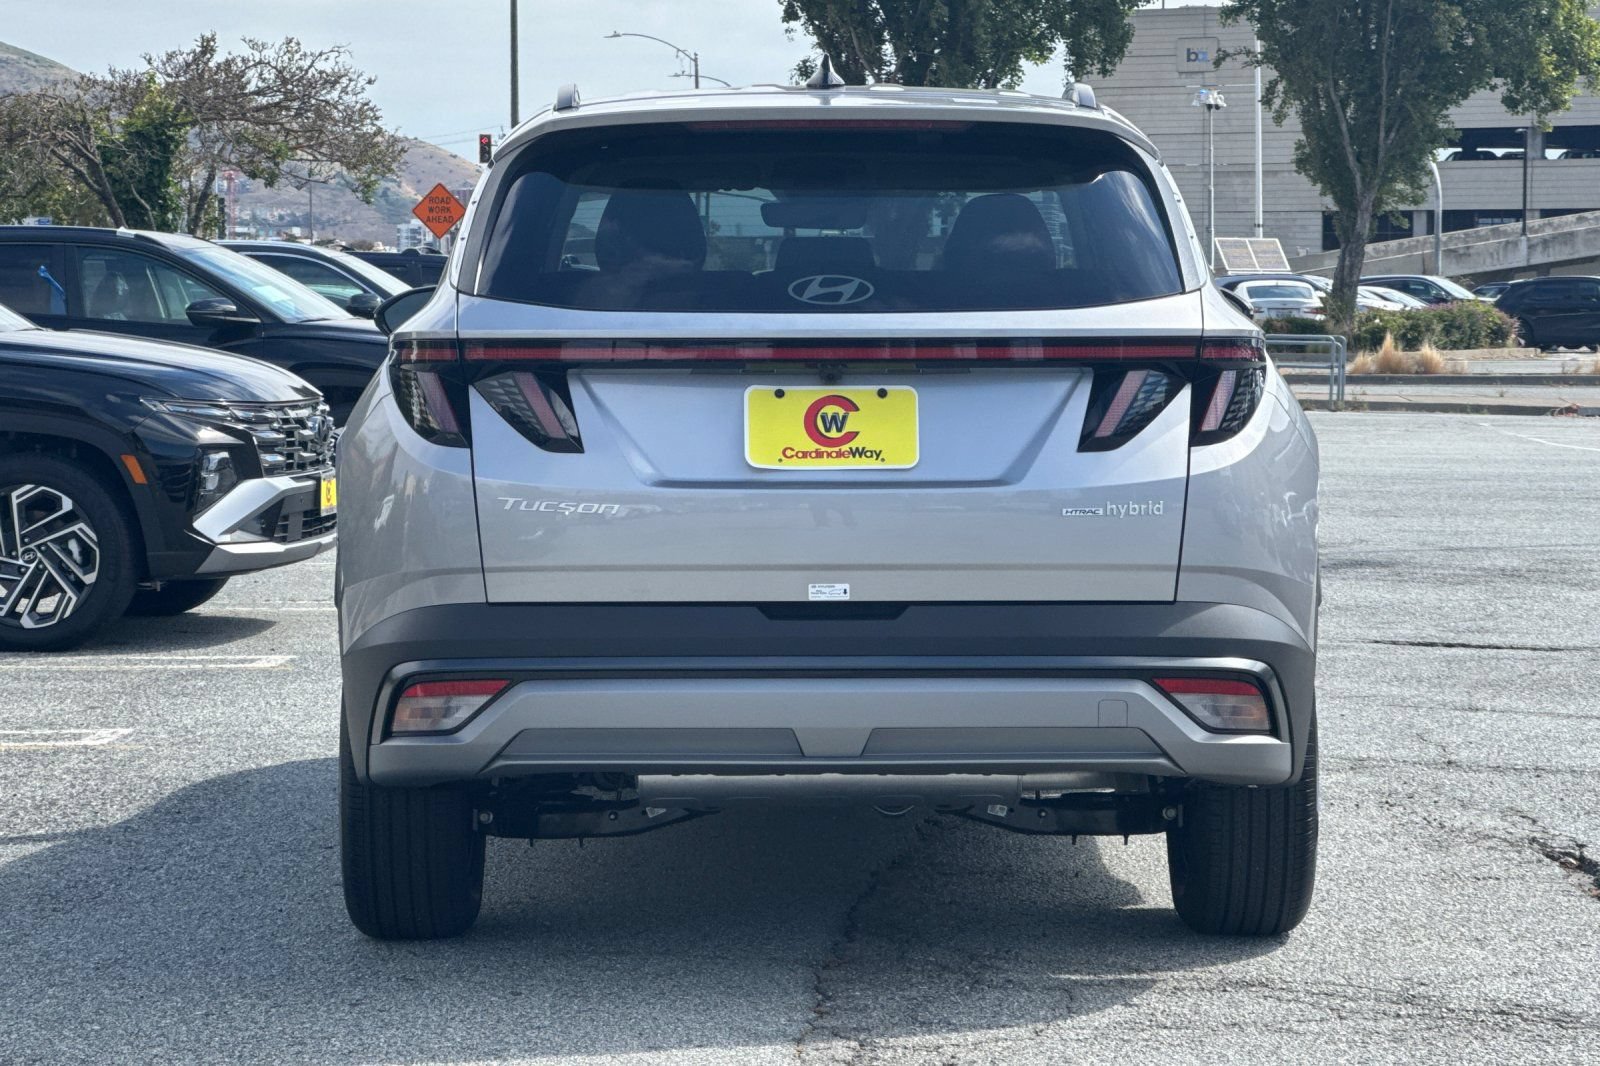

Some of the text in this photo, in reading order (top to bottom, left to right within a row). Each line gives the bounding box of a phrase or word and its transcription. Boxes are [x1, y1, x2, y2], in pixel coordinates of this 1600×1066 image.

[429, 196, 451, 204] ROAD
[782, 447, 882, 460] CardinaleWay
[1064, 500, 1164, 518] HTRAC hybrid
